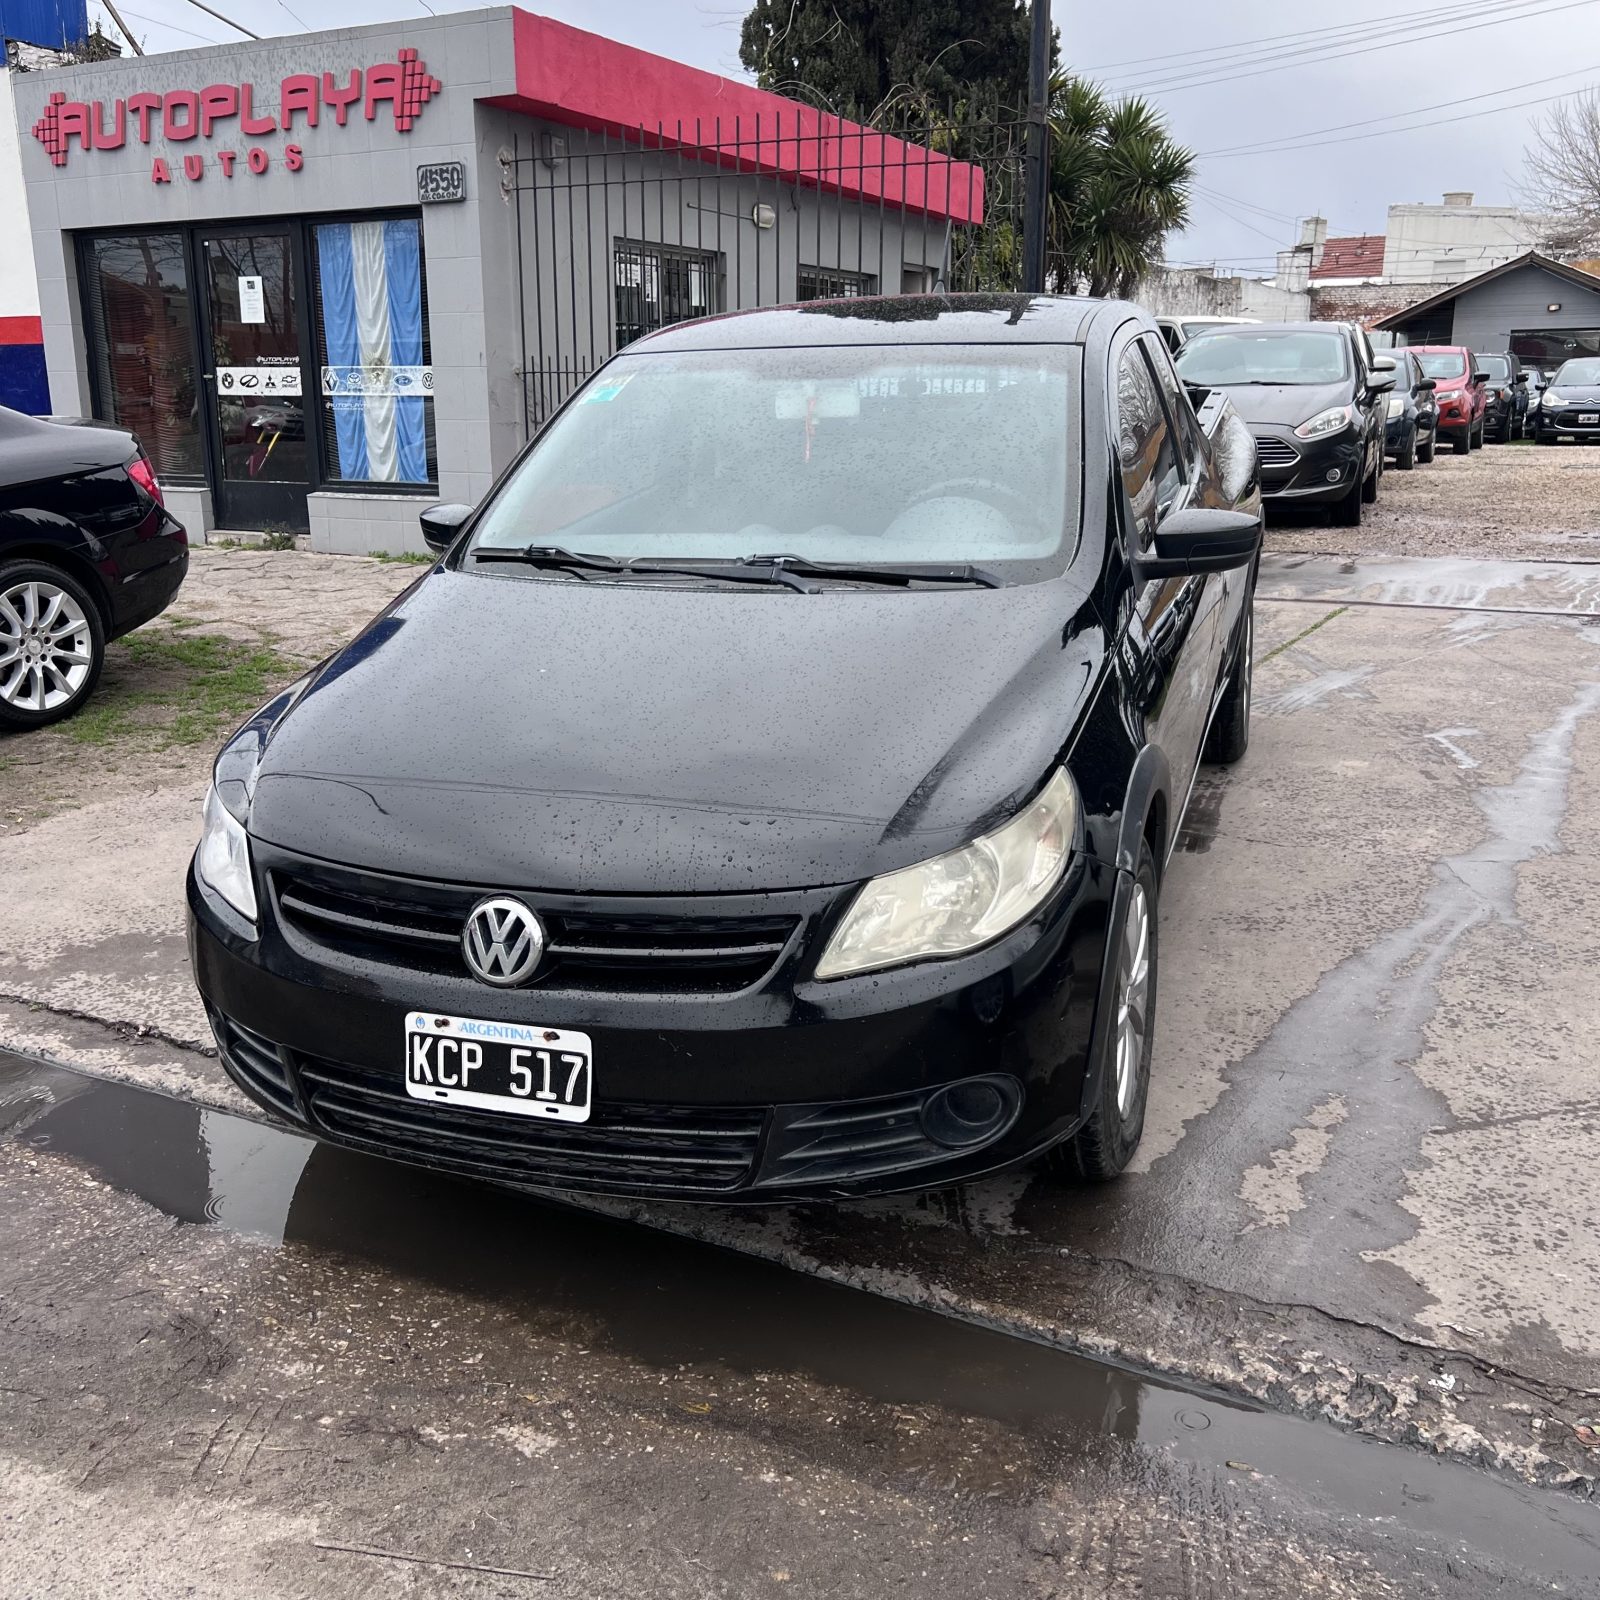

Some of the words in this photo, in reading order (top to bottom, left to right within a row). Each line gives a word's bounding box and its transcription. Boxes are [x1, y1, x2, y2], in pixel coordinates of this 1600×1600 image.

[58, 62, 405, 151] AUTOPLAYA
[151, 143, 304, 184] AUTOS
[420, 166, 460, 194] 4550
[459, 1021, 533, 1041] ARGENTINA
[413, 1034, 483, 1088] KCP
[509, 1047, 584, 1103] 517
